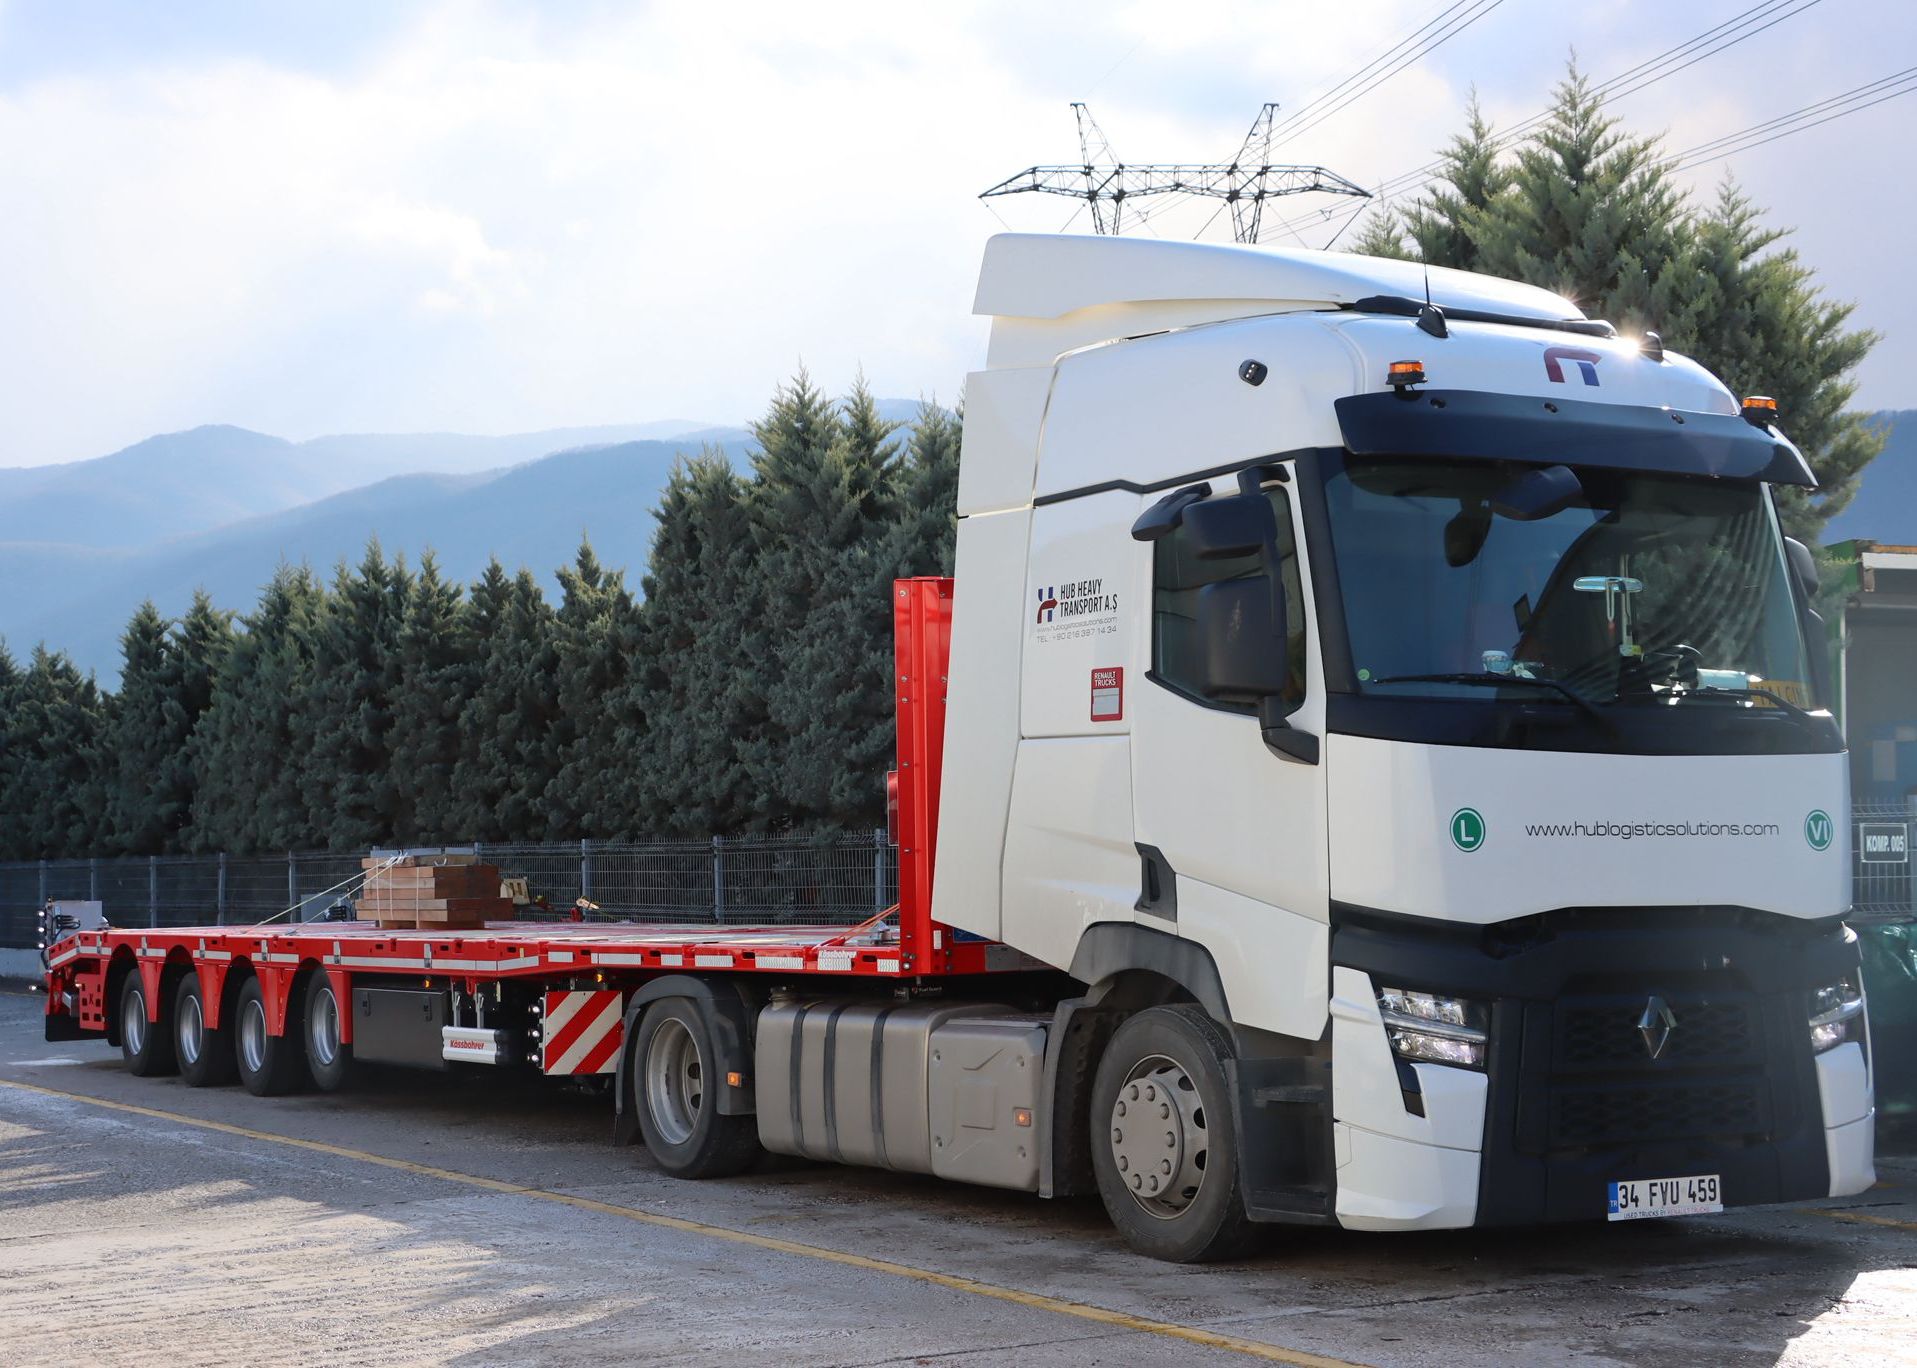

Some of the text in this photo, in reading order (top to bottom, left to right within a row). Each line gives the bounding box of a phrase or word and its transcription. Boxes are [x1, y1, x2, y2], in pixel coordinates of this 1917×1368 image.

[1060, 578, 1103, 600] HUB HEAVY
[1060, 596, 1103, 618] TRANSPORT
[1106, 625, 1117, 634] 34
[1094, 671, 1116, 680] RENAULT
[1094, 678, 1116, 687] TRUCKS
[1460, 819, 1475, 842] L
[1525, 820, 1780, 840] www.hublogisticsolutions.com
[1809, 820, 1829, 841] VI
[1866, 835, 1889, 852] KOMP.
[1618, 1178, 1717, 1209] 34 FVU 459
